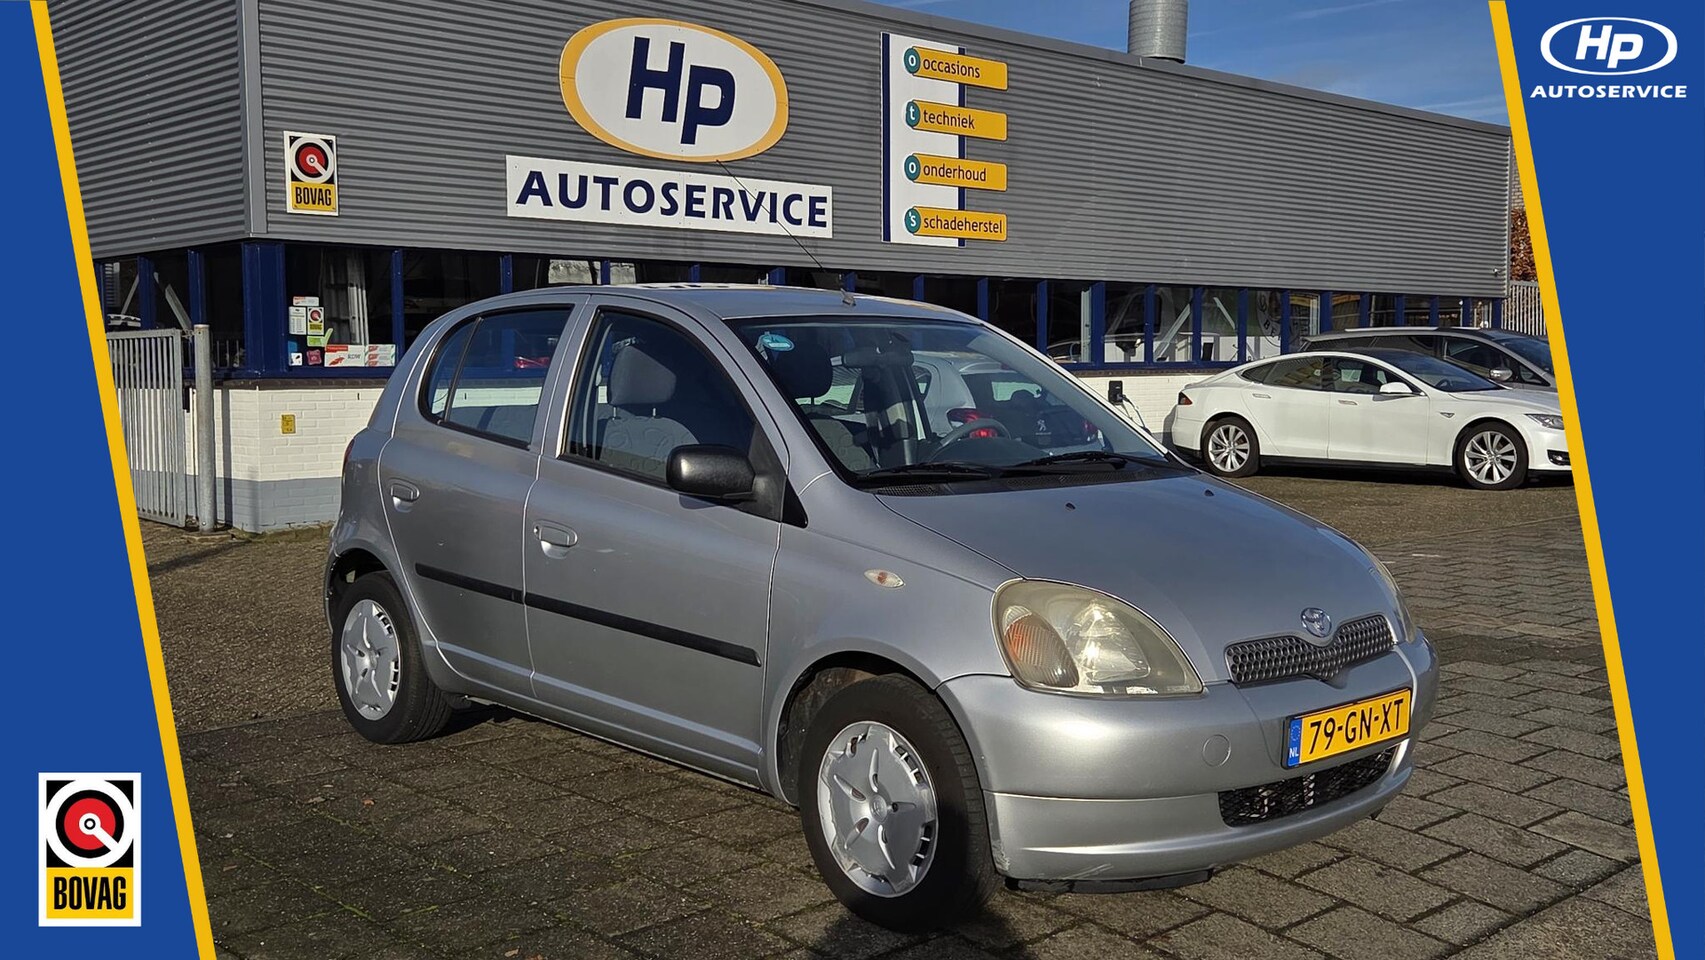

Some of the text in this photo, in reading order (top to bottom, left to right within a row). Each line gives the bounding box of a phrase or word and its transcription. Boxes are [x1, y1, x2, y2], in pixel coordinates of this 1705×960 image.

[923, 58, 981, 78] occasions
[625, 36, 736, 145] Hp
[923, 109, 975, 129] techniek
[923, 163, 987, 182] onderhoud
[295, 186, 332, 206] BOVAG
[515, 170, 828, 228] AUTOSERVICE
[923, 214, 1003, 234] schadeherstel
[1309, 698, 1404, 755] 79-GN-XT
[1289, 747, 1299, 759] NL
